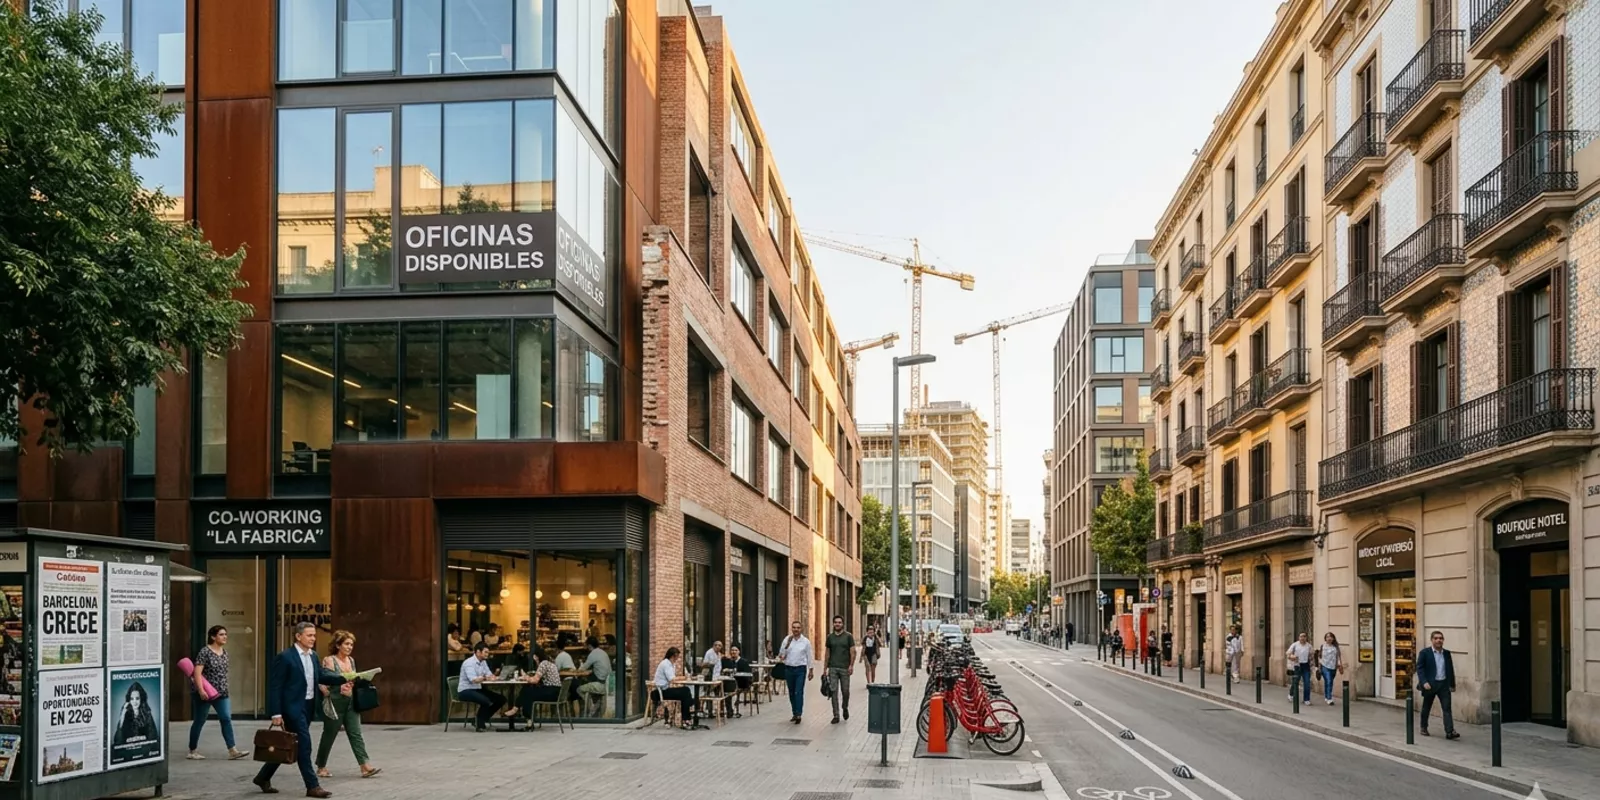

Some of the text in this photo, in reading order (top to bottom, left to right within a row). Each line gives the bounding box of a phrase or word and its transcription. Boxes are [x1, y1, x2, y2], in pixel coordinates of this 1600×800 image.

[405, 223, 534, 249] OFICINAS
[405, 251, 544, 272] DISPONIBLES
[208, 509, 322, 525] CO-WORKING
[42, 595, 99, 609] BARCELONA
[42, 611, 98, 635] CRECE
[54, 682, 89, 697] NUEVAS
[51, 711, 65, 726] EN
